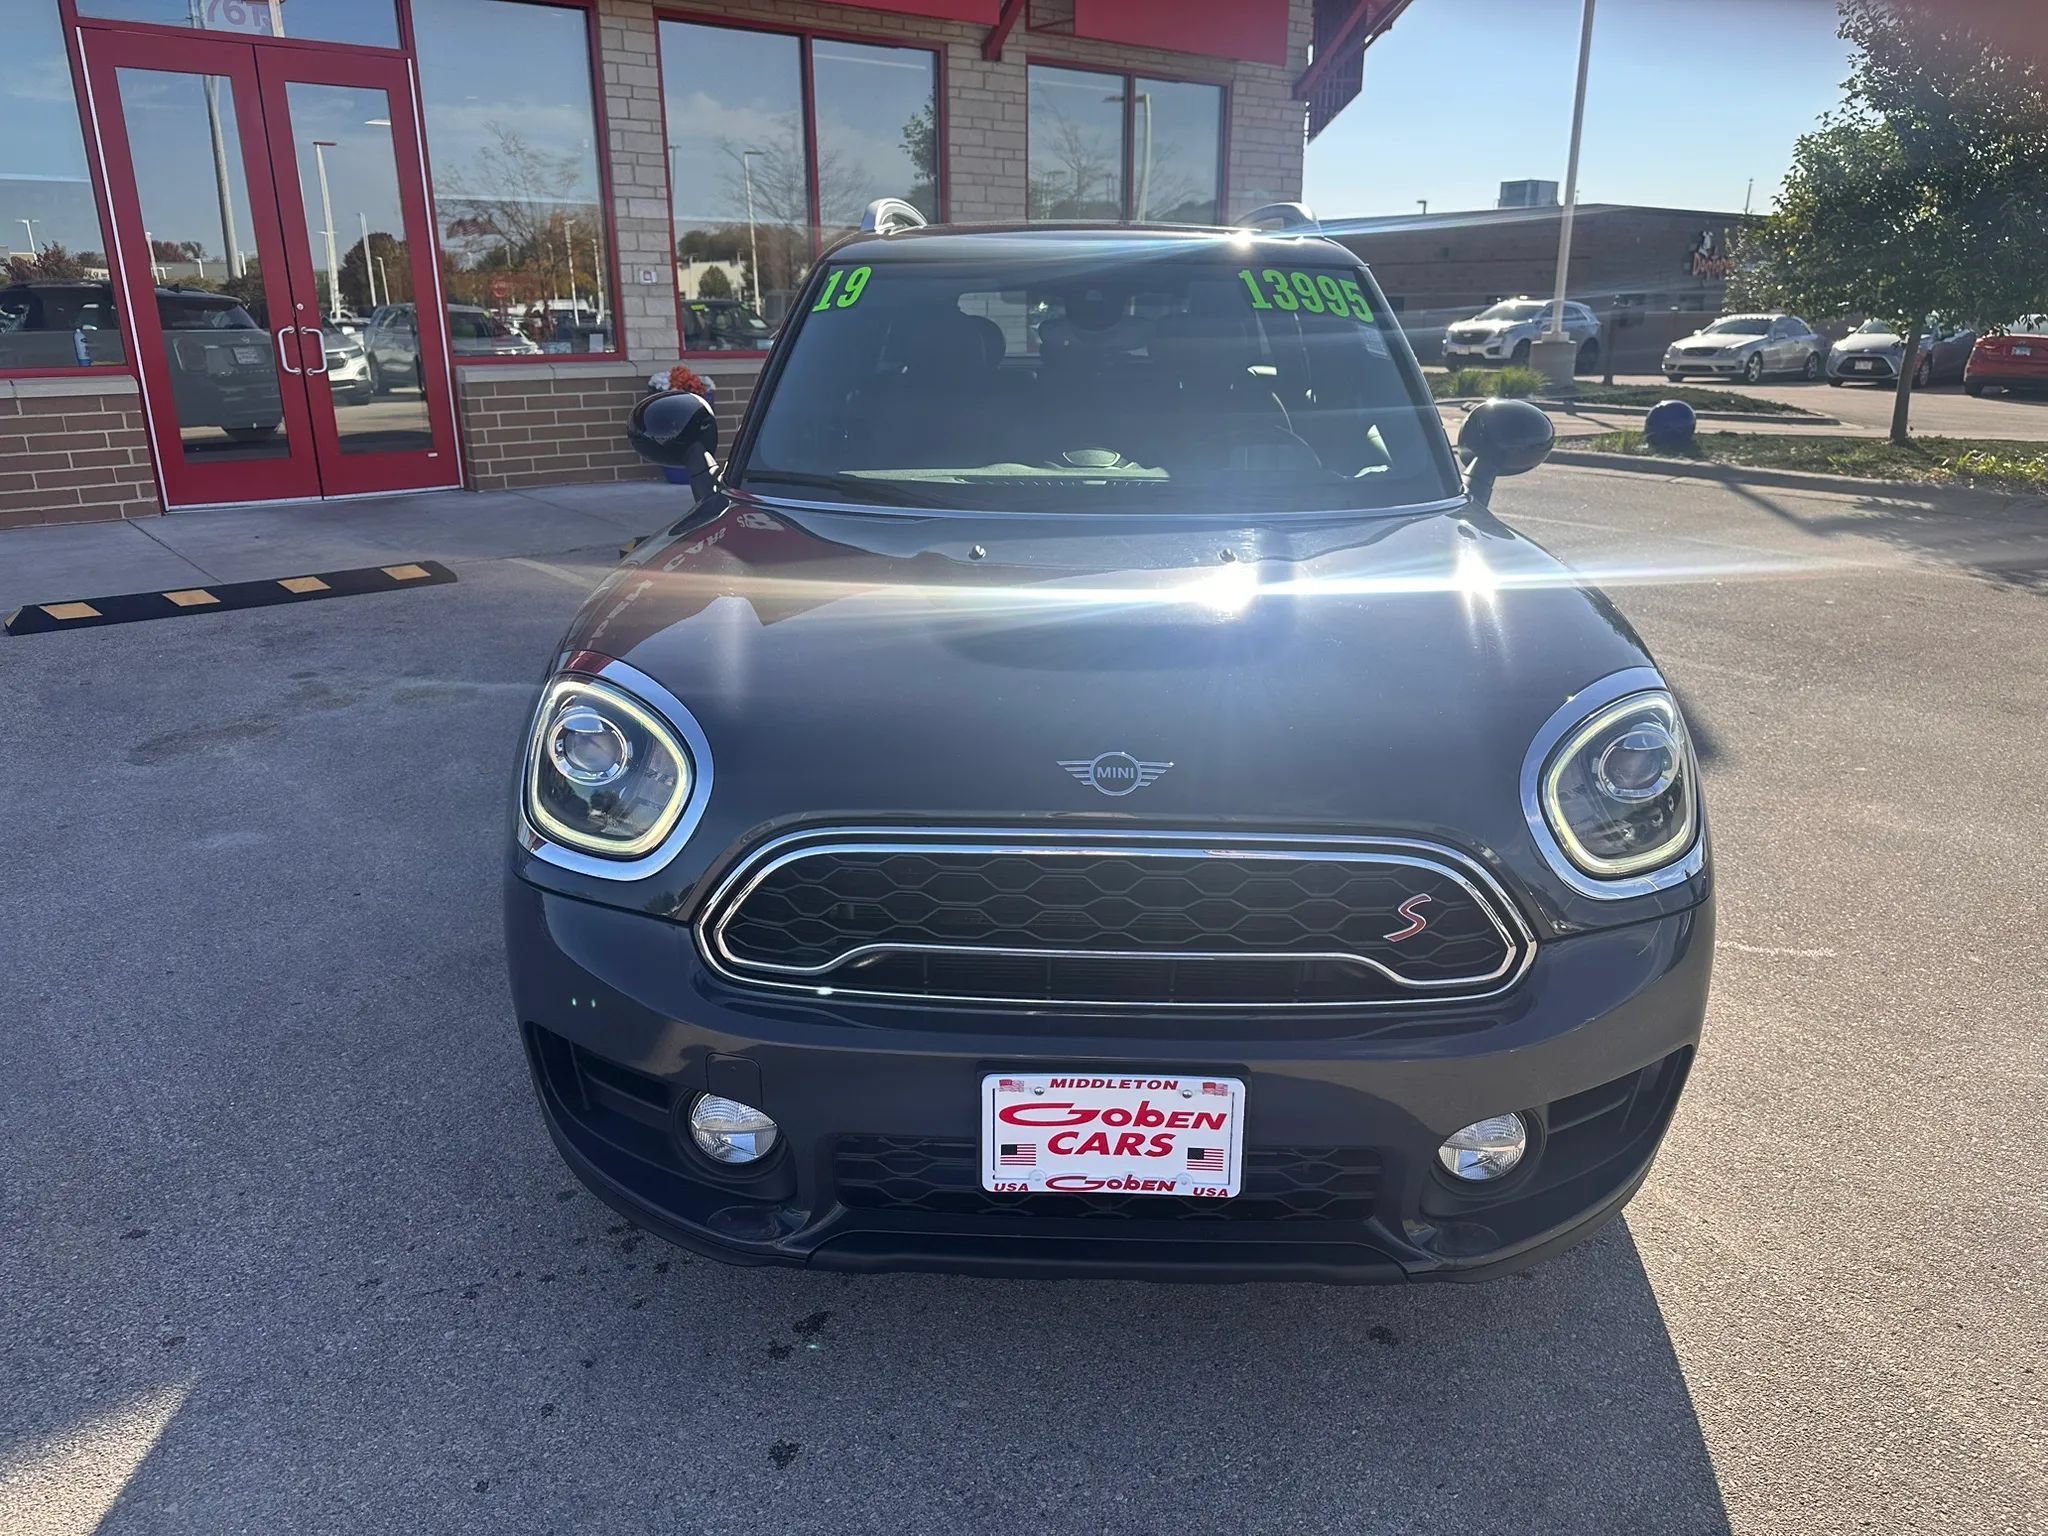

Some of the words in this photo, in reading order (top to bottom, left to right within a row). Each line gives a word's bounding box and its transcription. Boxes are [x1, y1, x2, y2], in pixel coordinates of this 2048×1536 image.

[812, 266, 872, 312] 19
[1238, 269, 1375, 323] 13995
[1096, 766, 1135, 780] MINI
[1383, 893, 1432, 943] S
[1050, 1078, 1179, 1091] MIDDLETON
[1047, 1131, 1177, 1158] CARS
[993, 1182, 1029, 1193] USA
[1192, 1186, 1229, 1198] USA
